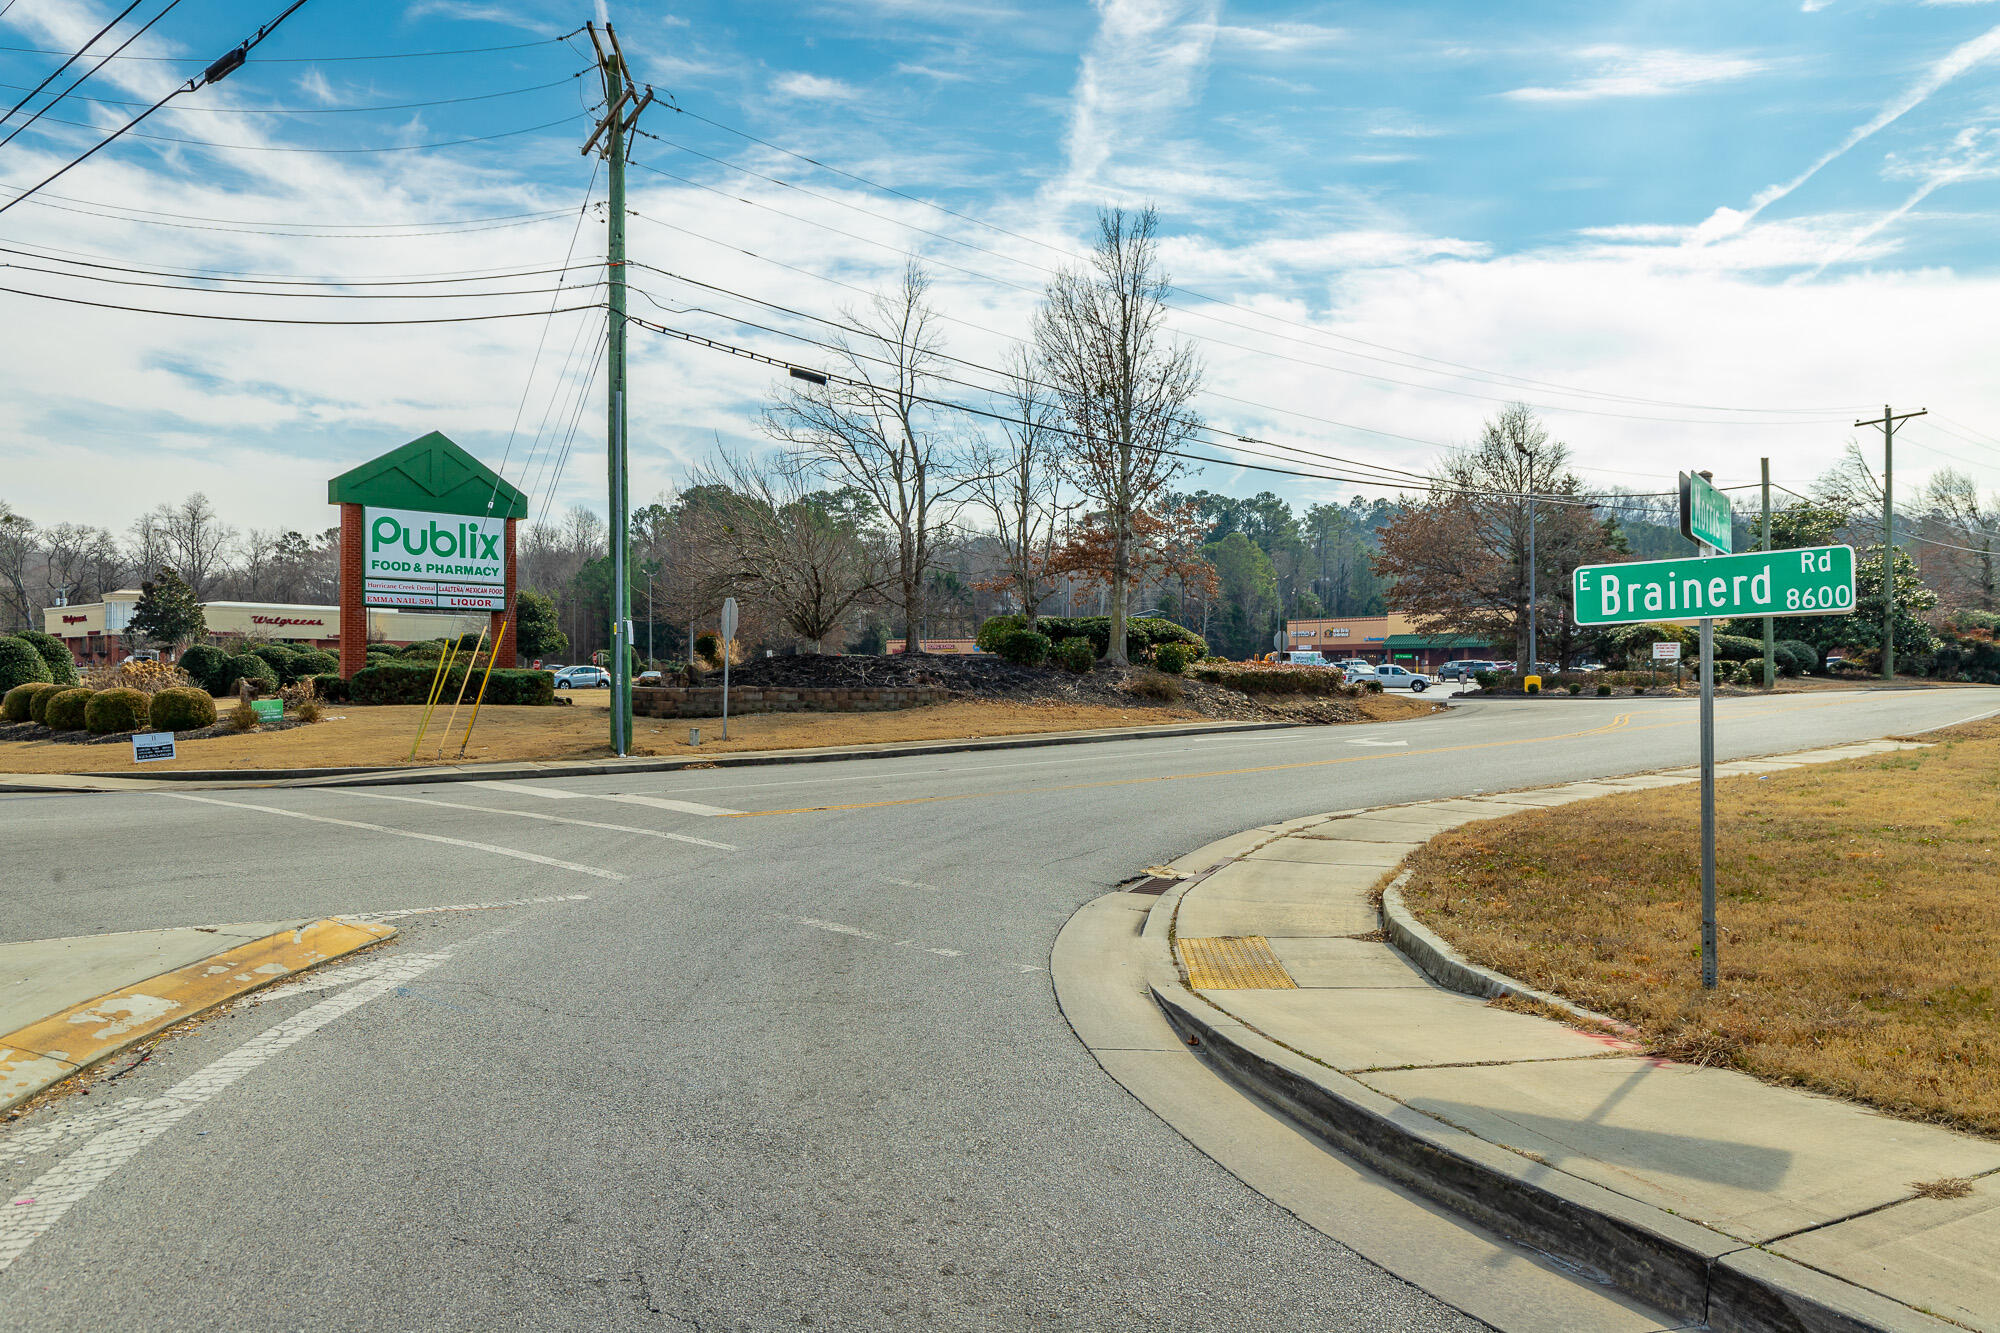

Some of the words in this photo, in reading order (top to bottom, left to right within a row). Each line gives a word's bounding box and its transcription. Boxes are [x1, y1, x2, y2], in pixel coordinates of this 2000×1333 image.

[1694, 483, 1720, 539] Morris
[372, 516, 499, 561] Publix
[371, 560, 411, 571] FOOD
[413, 563, 422, 573] &
[426, 564, 499, 576] PHARMACY
[367, 582, 397, 590] Hurricane
[416, 584, 435, 592] Dental
[1579, 571, 1591, 591] E
[1601, 565, 1772, 616] Brainerd
[1800, 550, 1832, 574] Rd
[465, 587, 488, 595] MEXICAN
[1786, 584, 1851, 610] 8600
[367, 595, 394, 604] EMMA
[396, 597, 418, 605] NAIL
[450, 598, 492, 607] LIQUOR
[250, 615, 325, 627] Walgreens
